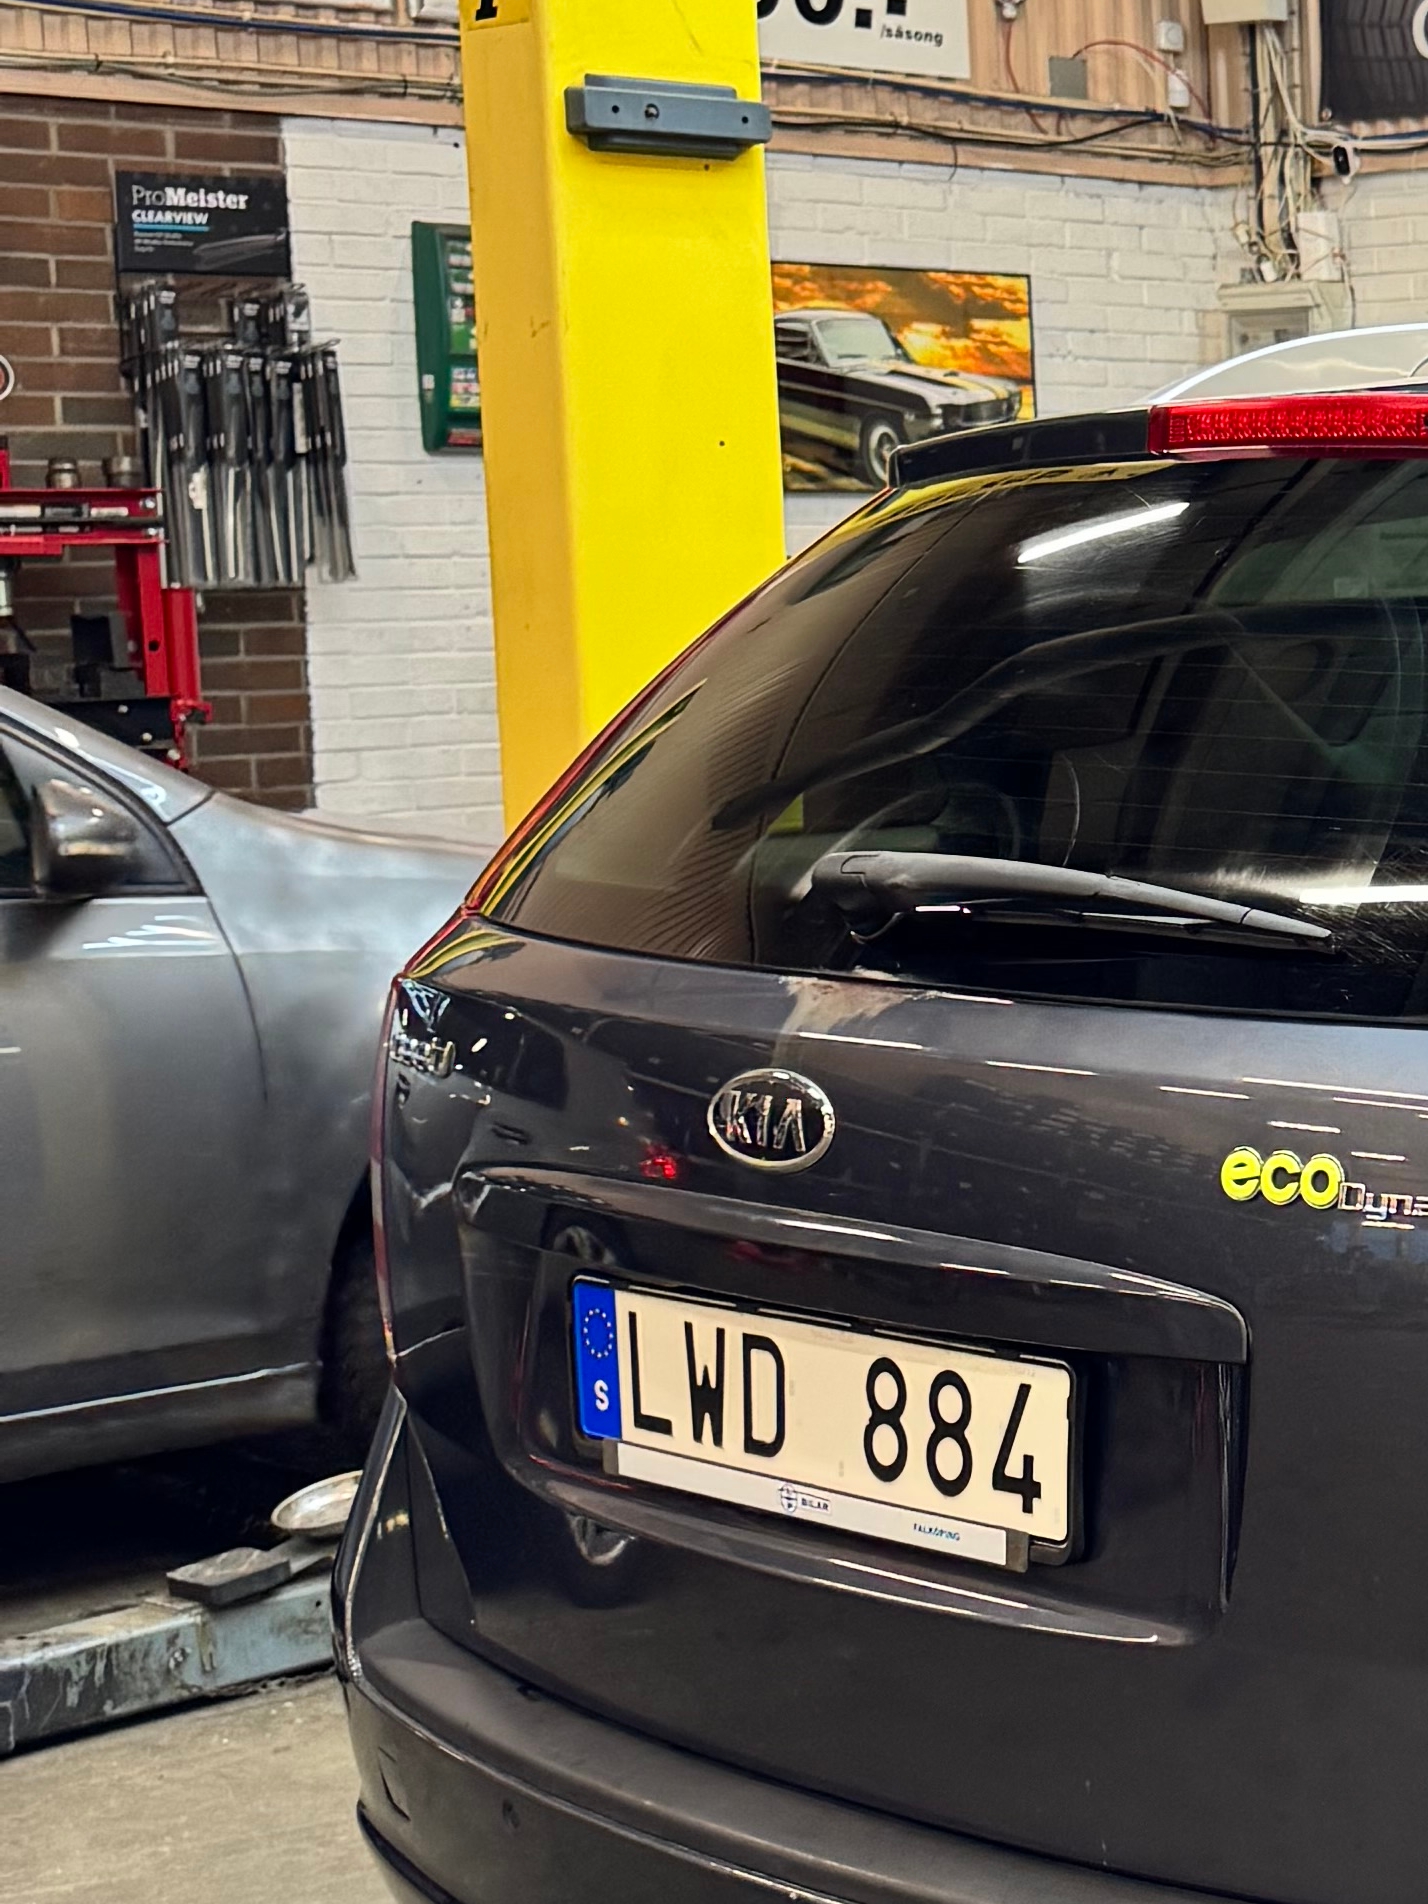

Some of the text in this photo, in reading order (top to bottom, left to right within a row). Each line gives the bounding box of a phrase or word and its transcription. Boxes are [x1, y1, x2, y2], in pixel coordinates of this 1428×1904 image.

[131, 184, 249, 210] ProMeister
[132, 209, 209, 225] CLEARVIEW
[593, 1378, 609, 1412] S
[627, 1311, 1043, 1515] LWD 884
